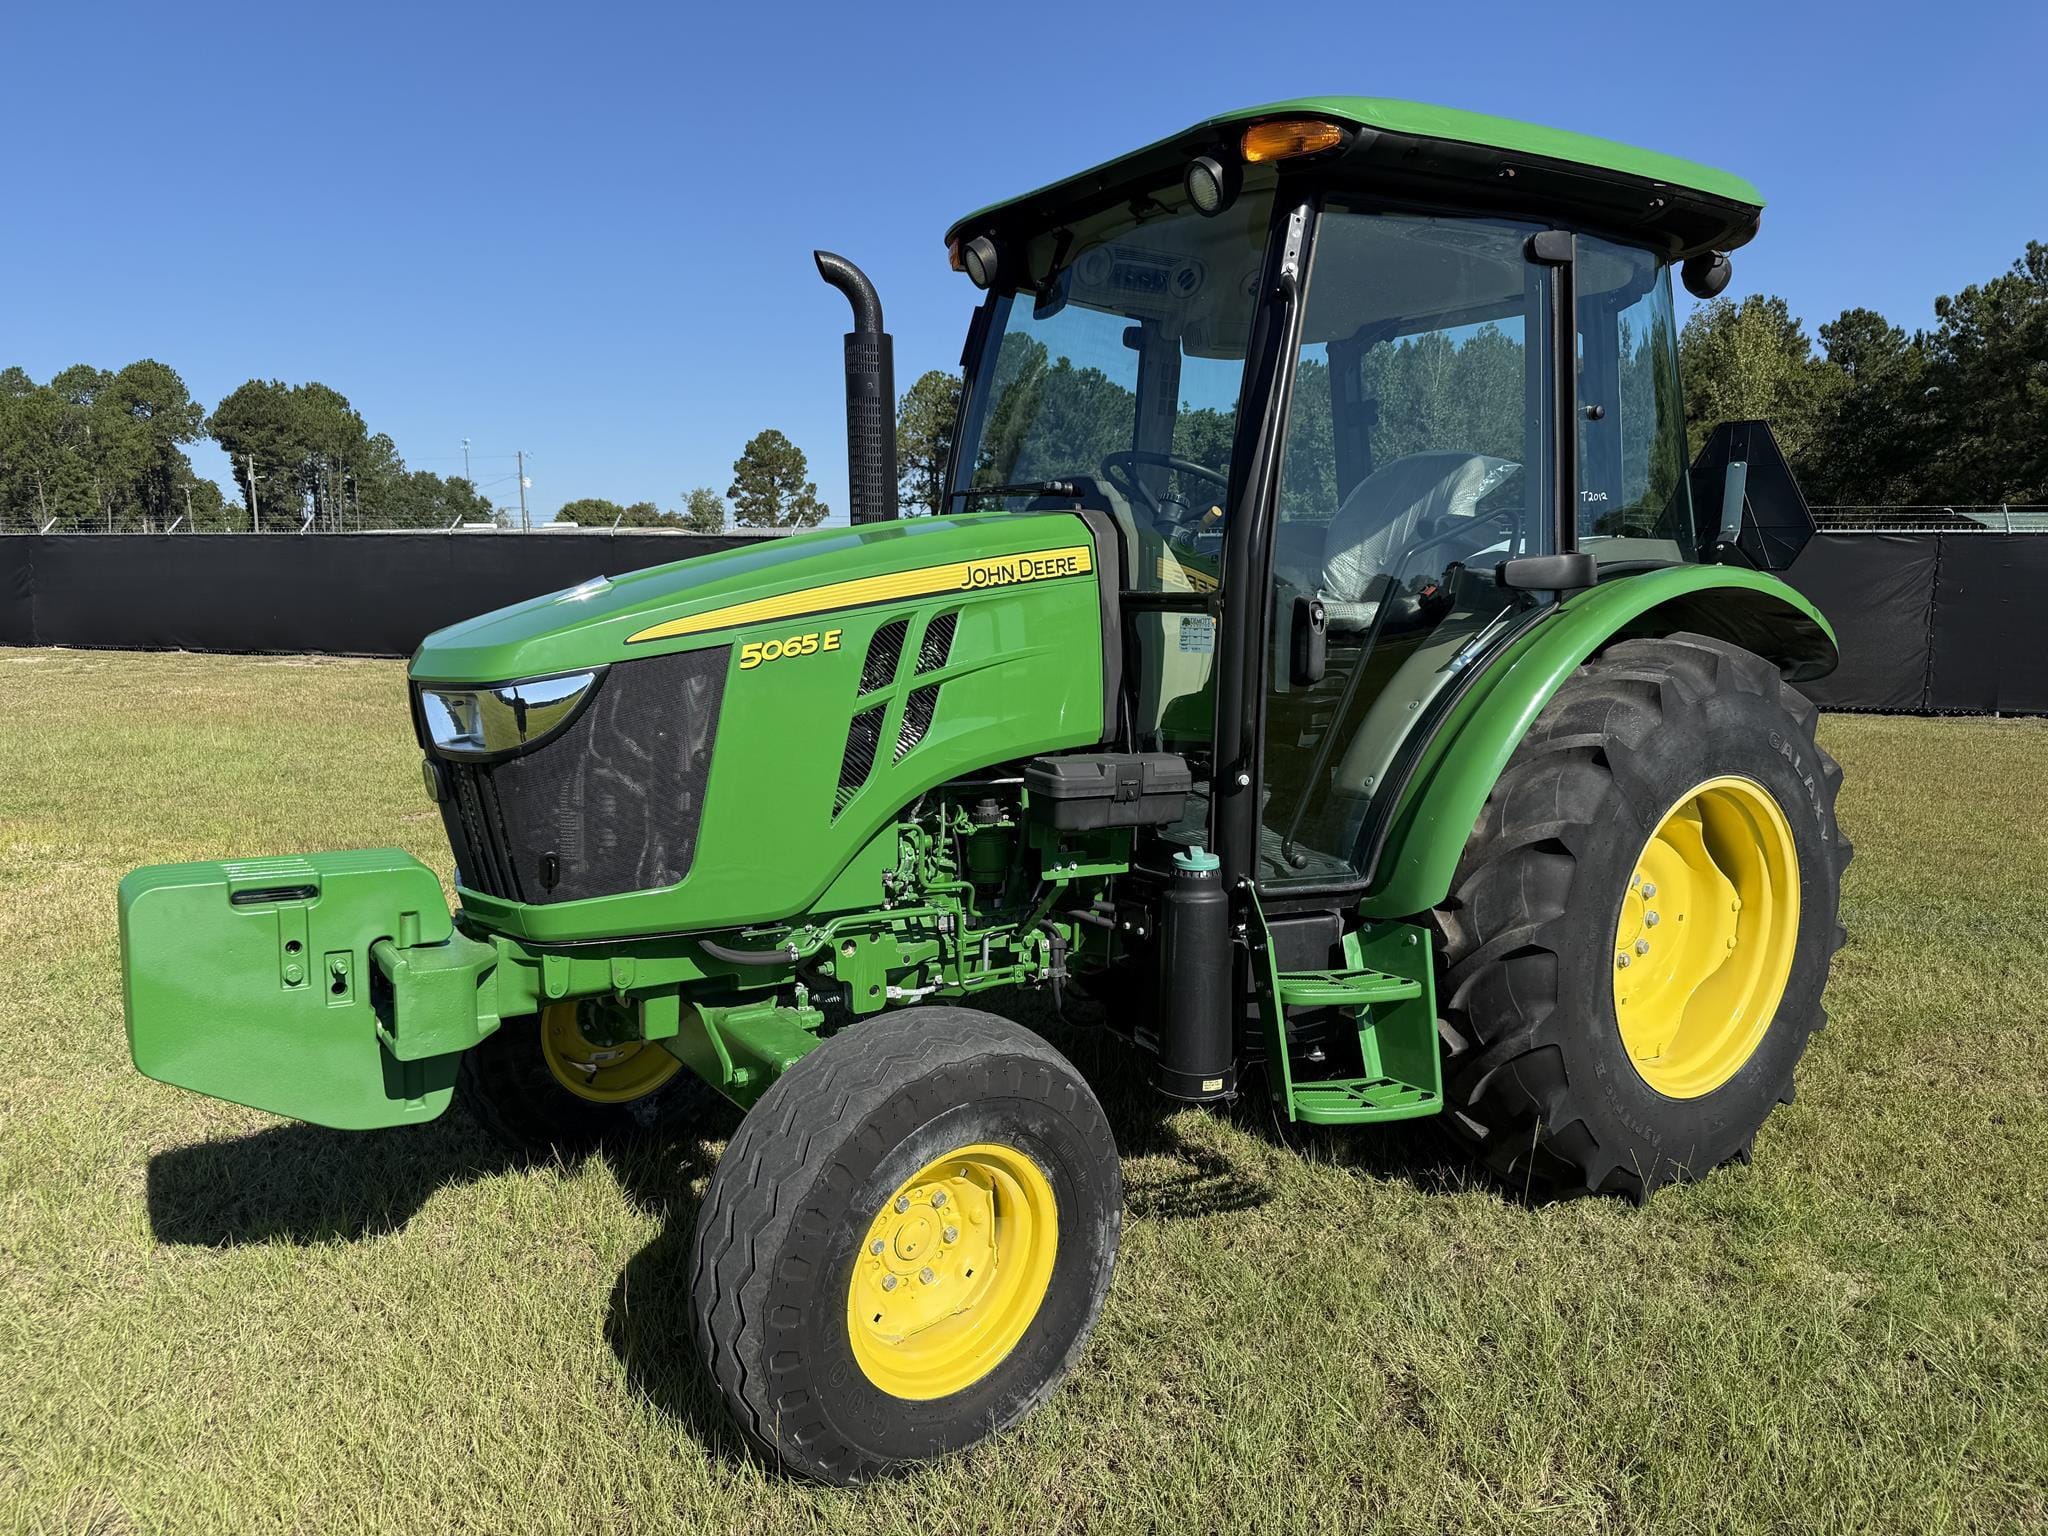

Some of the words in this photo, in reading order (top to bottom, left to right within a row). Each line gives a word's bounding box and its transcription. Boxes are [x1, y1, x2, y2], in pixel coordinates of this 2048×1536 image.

[1580, 490, 1608, 502] T2012
[961, 564, 1015, 587] JOHN
[1018, 557, 1078, 579] DEERE
[740, 633, 820, 670] 5065
[823, 629, 843, 652] E
[1767, 729, 1829, 842] GALAXY
